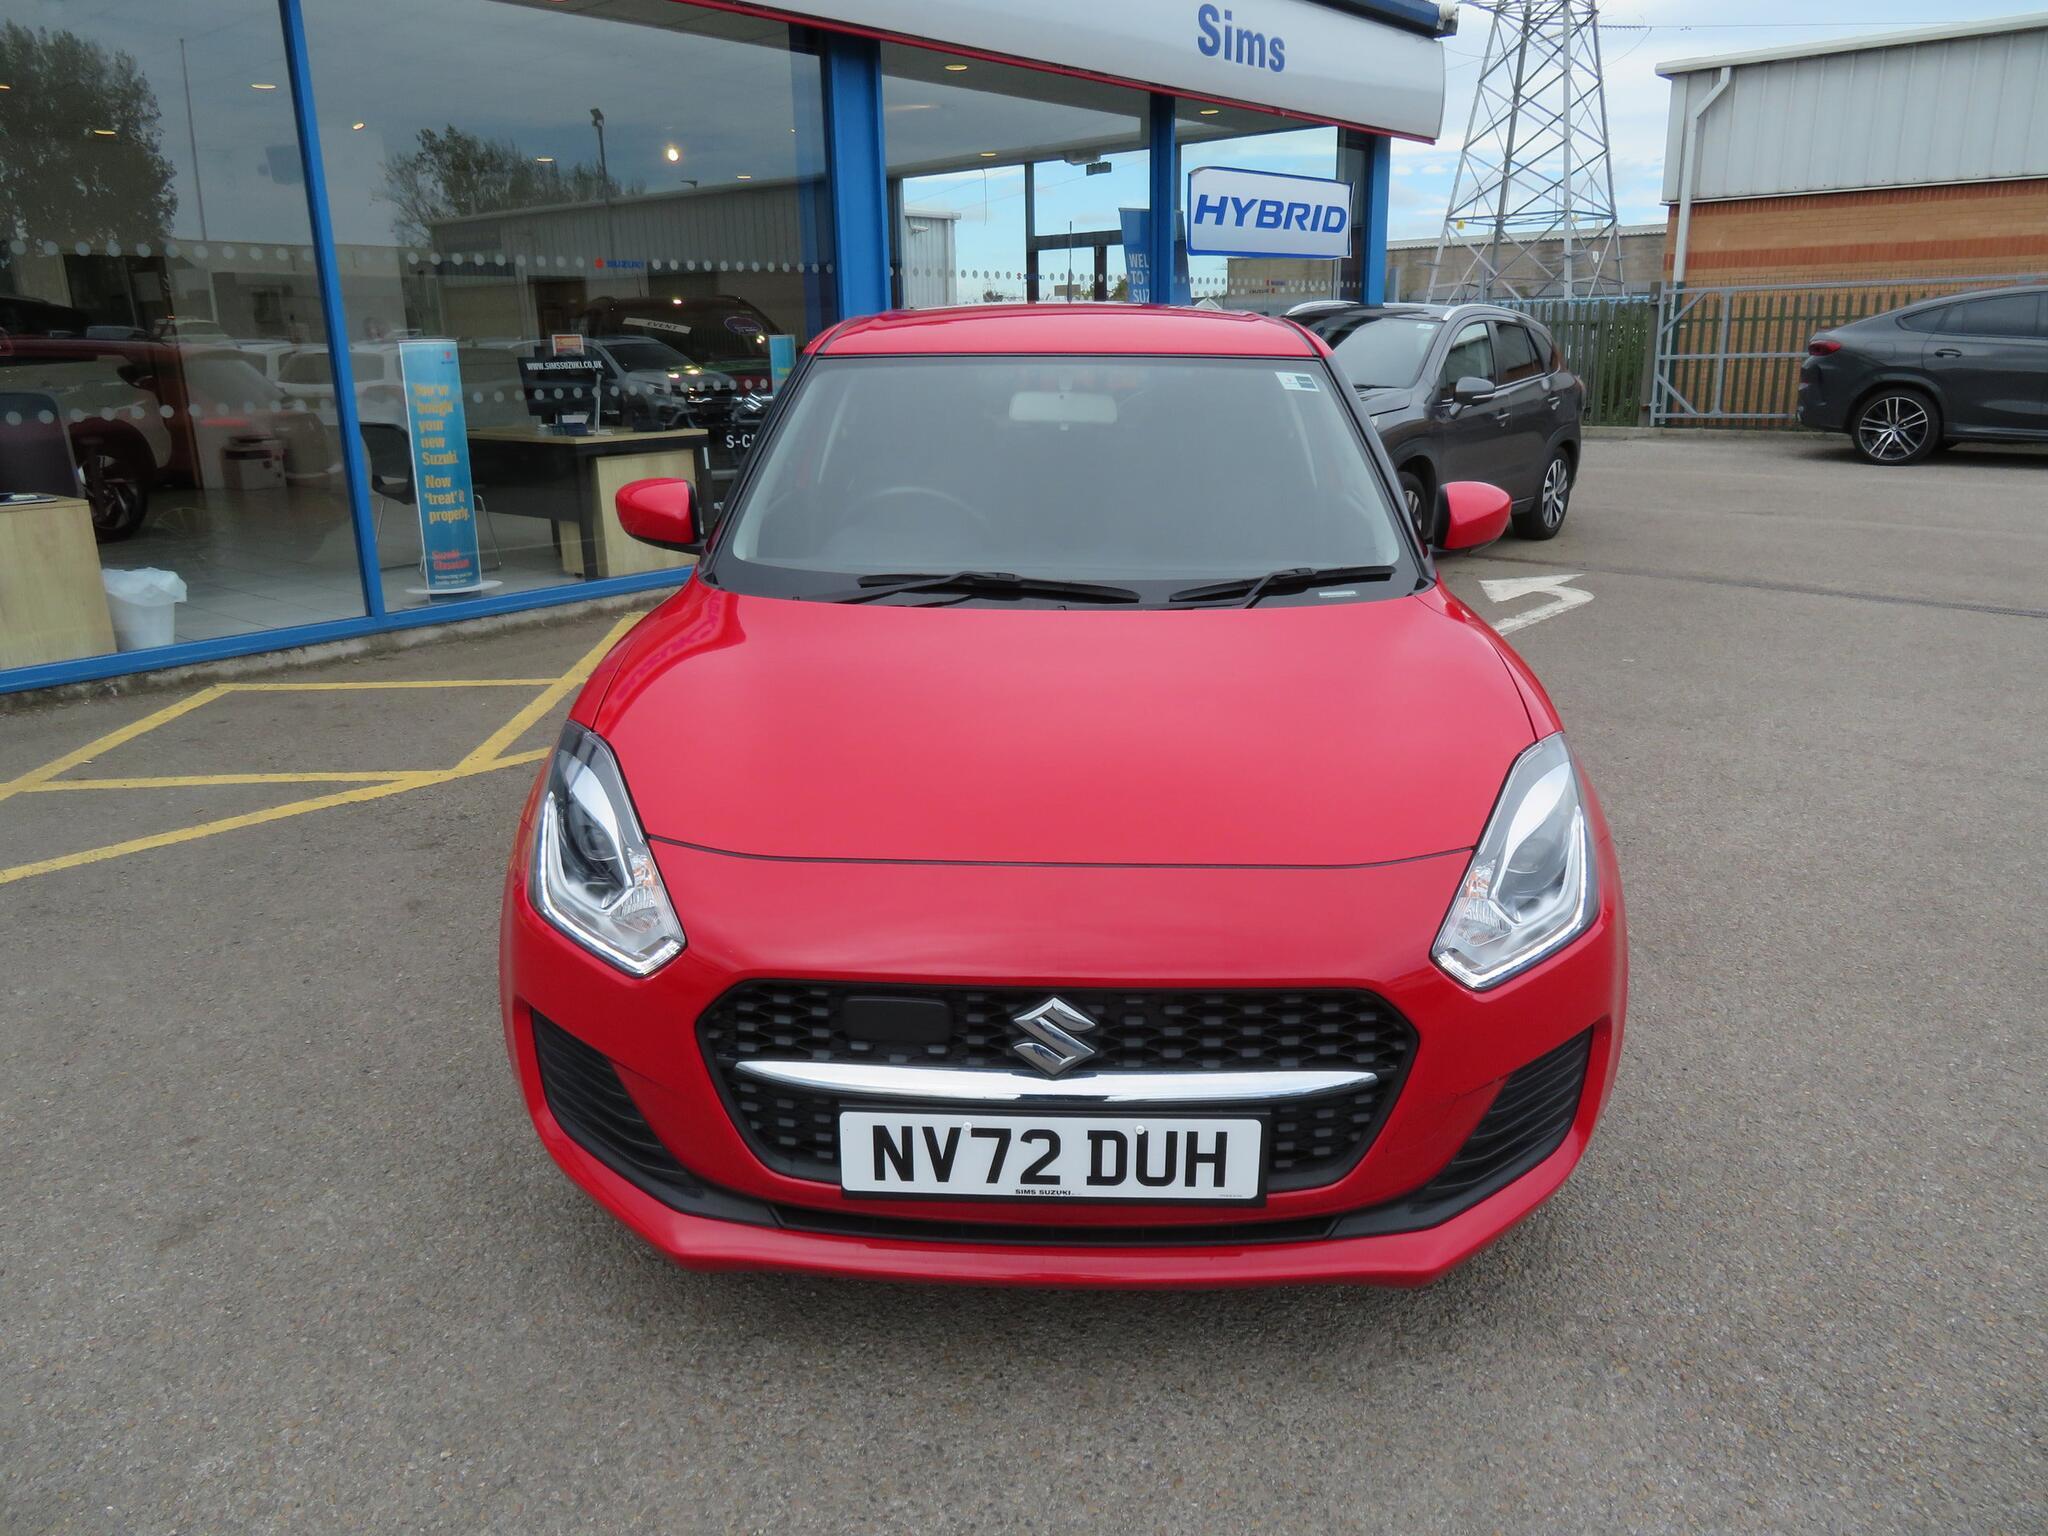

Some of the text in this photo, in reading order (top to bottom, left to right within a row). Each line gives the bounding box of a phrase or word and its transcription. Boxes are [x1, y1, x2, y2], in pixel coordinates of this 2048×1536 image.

[1198, 4, 1285, 72] Sims
[1195, 194, 1347, 233] HYBRID
[425, 474, 452, 489] Now
[872, 1125, 1228, 1188] NV72 DUH
